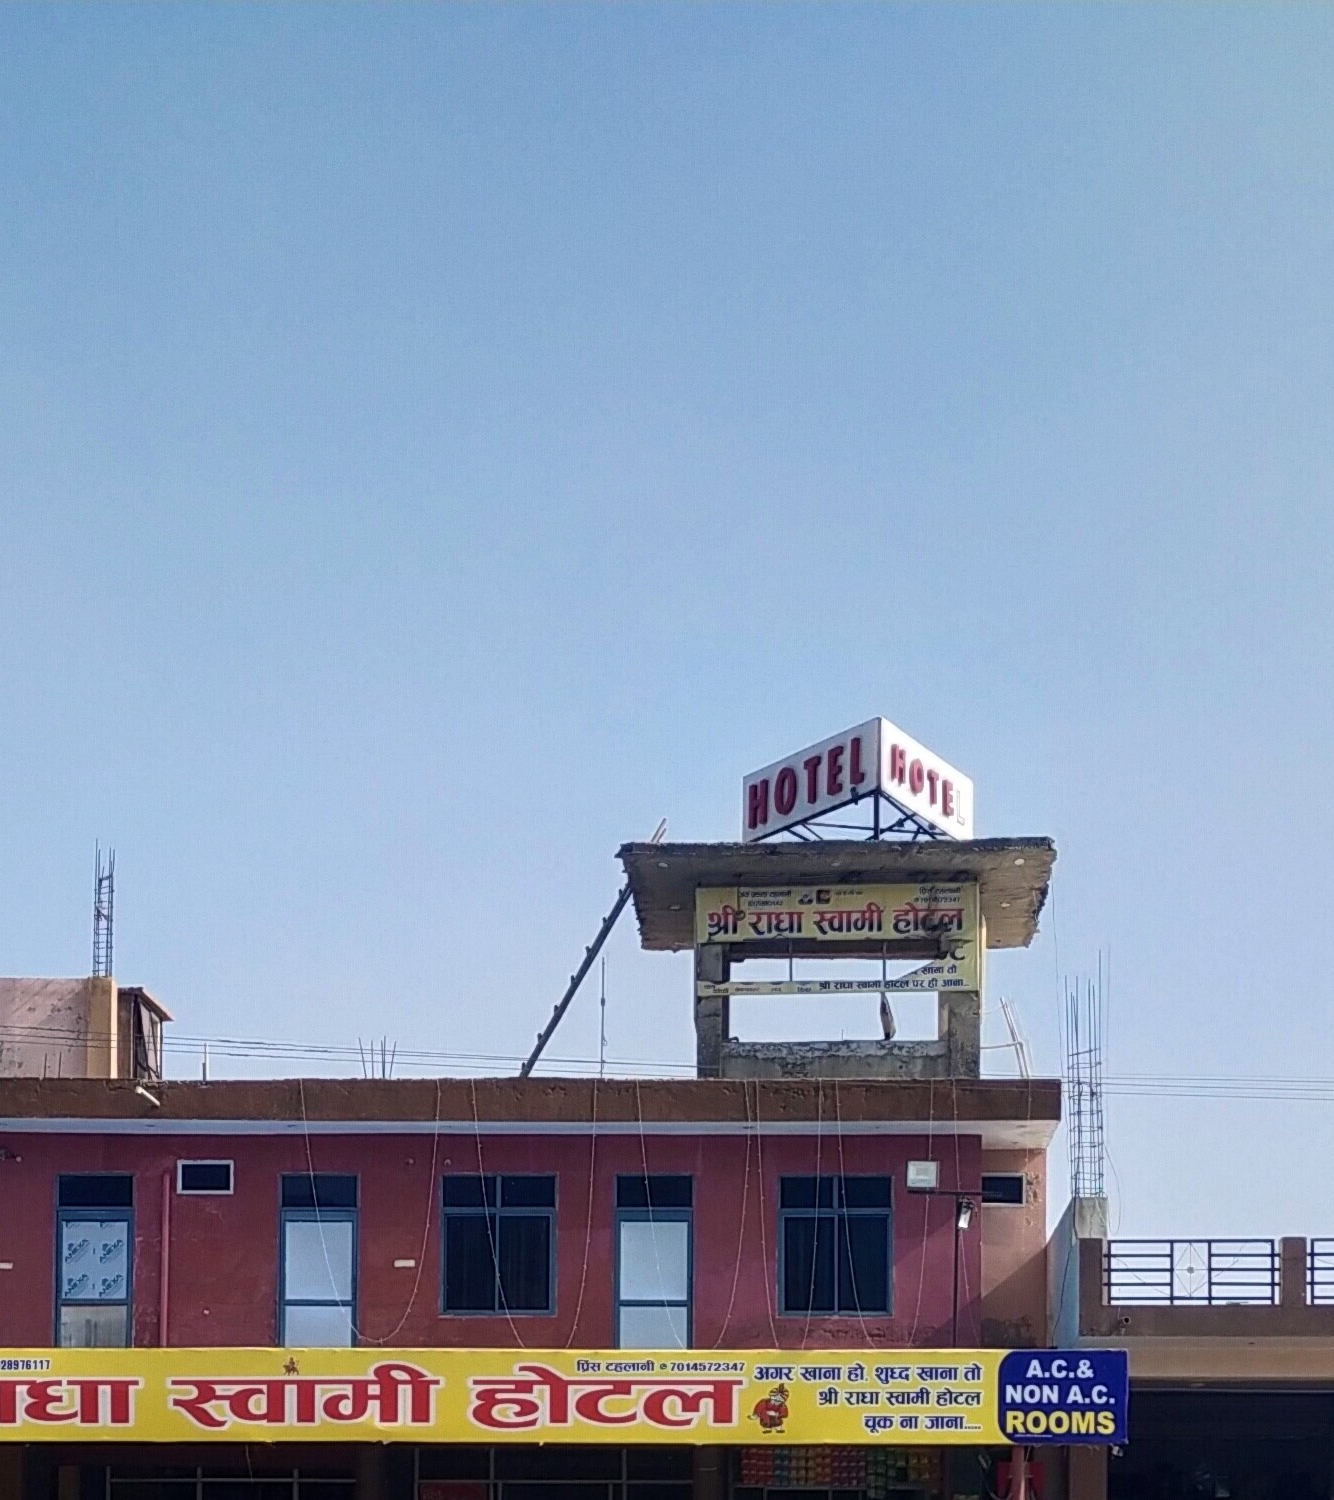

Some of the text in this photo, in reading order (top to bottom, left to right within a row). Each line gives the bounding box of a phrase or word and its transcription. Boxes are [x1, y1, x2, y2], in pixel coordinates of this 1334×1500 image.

[748, 737, 865, 830] HOTEL
[708, 902, 964, 935] श्री राधा स्वामी होटल
[606, 1360, 654, 1372] टहलानी
[670, 1362, 745, 1372] 7014572347
[754, 1366, 794, 1380] अगर
[800, 1366, 841, 1380] खाना
[917, 1366, 959, 1380] खाना
[964, 1363, 982, 1381] तो
[171, 1364, 440, 1427] स्वामी
[472, 1366, 743, 1428] होटल
[819, 1387, 982, 1406] श्री राधा स्वामी होटल
[1005, 1385, 1116, 1403] NON A.C.
[864, 1416, 895, 1433] चूक
[900, 1416, 919, 1429] ना
[1006, 1410, 1115, 1434] ROOMS
